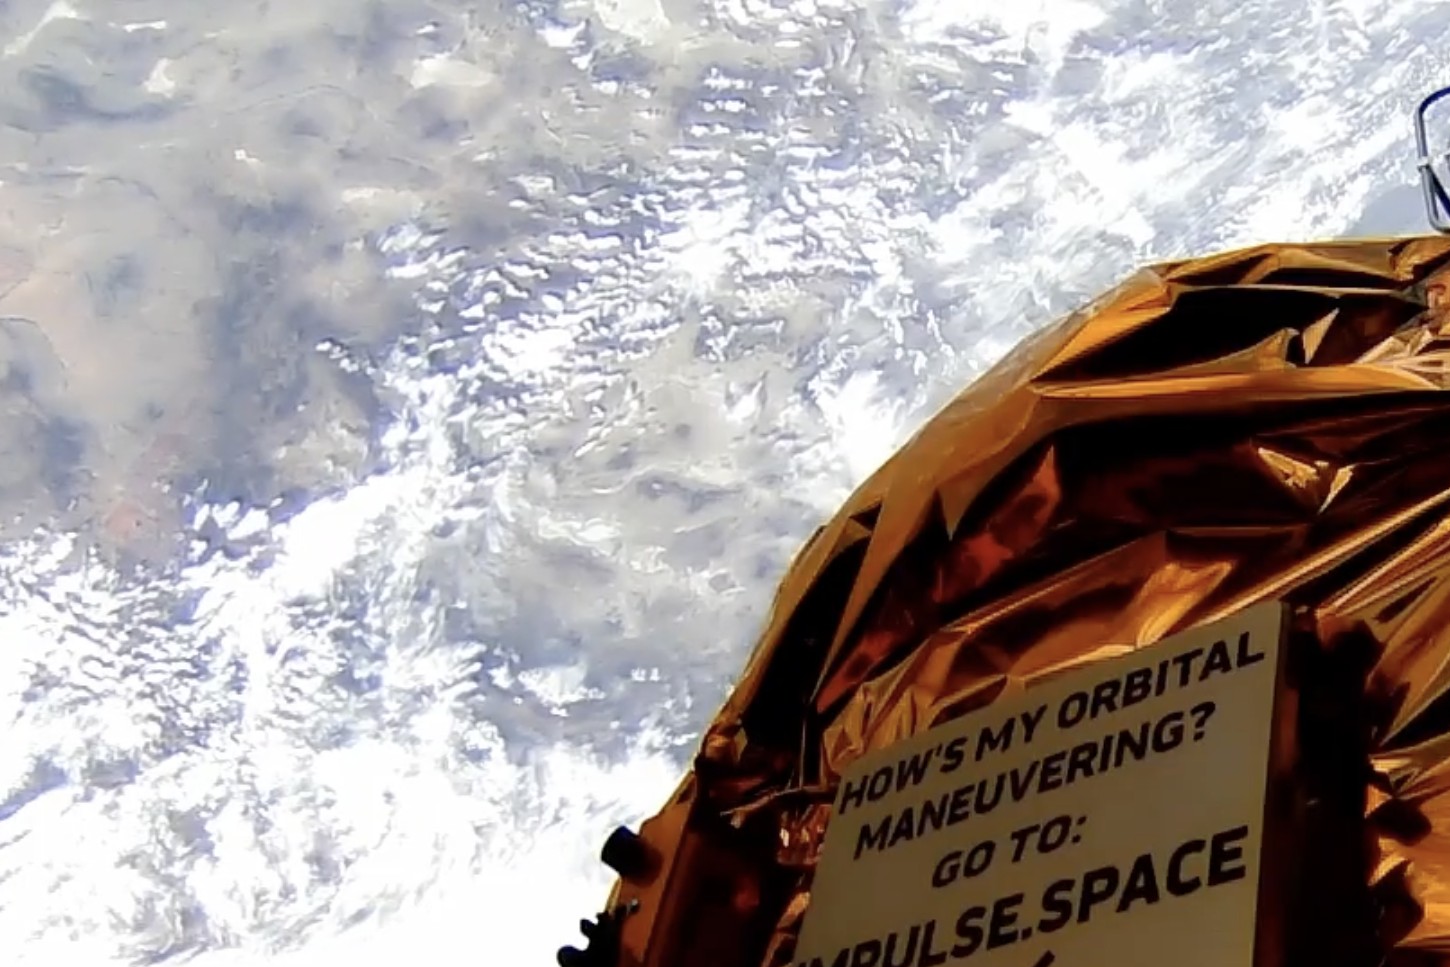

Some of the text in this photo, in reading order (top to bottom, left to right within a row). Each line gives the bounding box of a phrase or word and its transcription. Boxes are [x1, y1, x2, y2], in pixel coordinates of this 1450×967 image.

[839, 631, 1265, 814] HOW'S MY ORBITAL
[853, 701, 1216, 859] MANEUVERING?
[932, 814, 1087, 888] GO TO:
